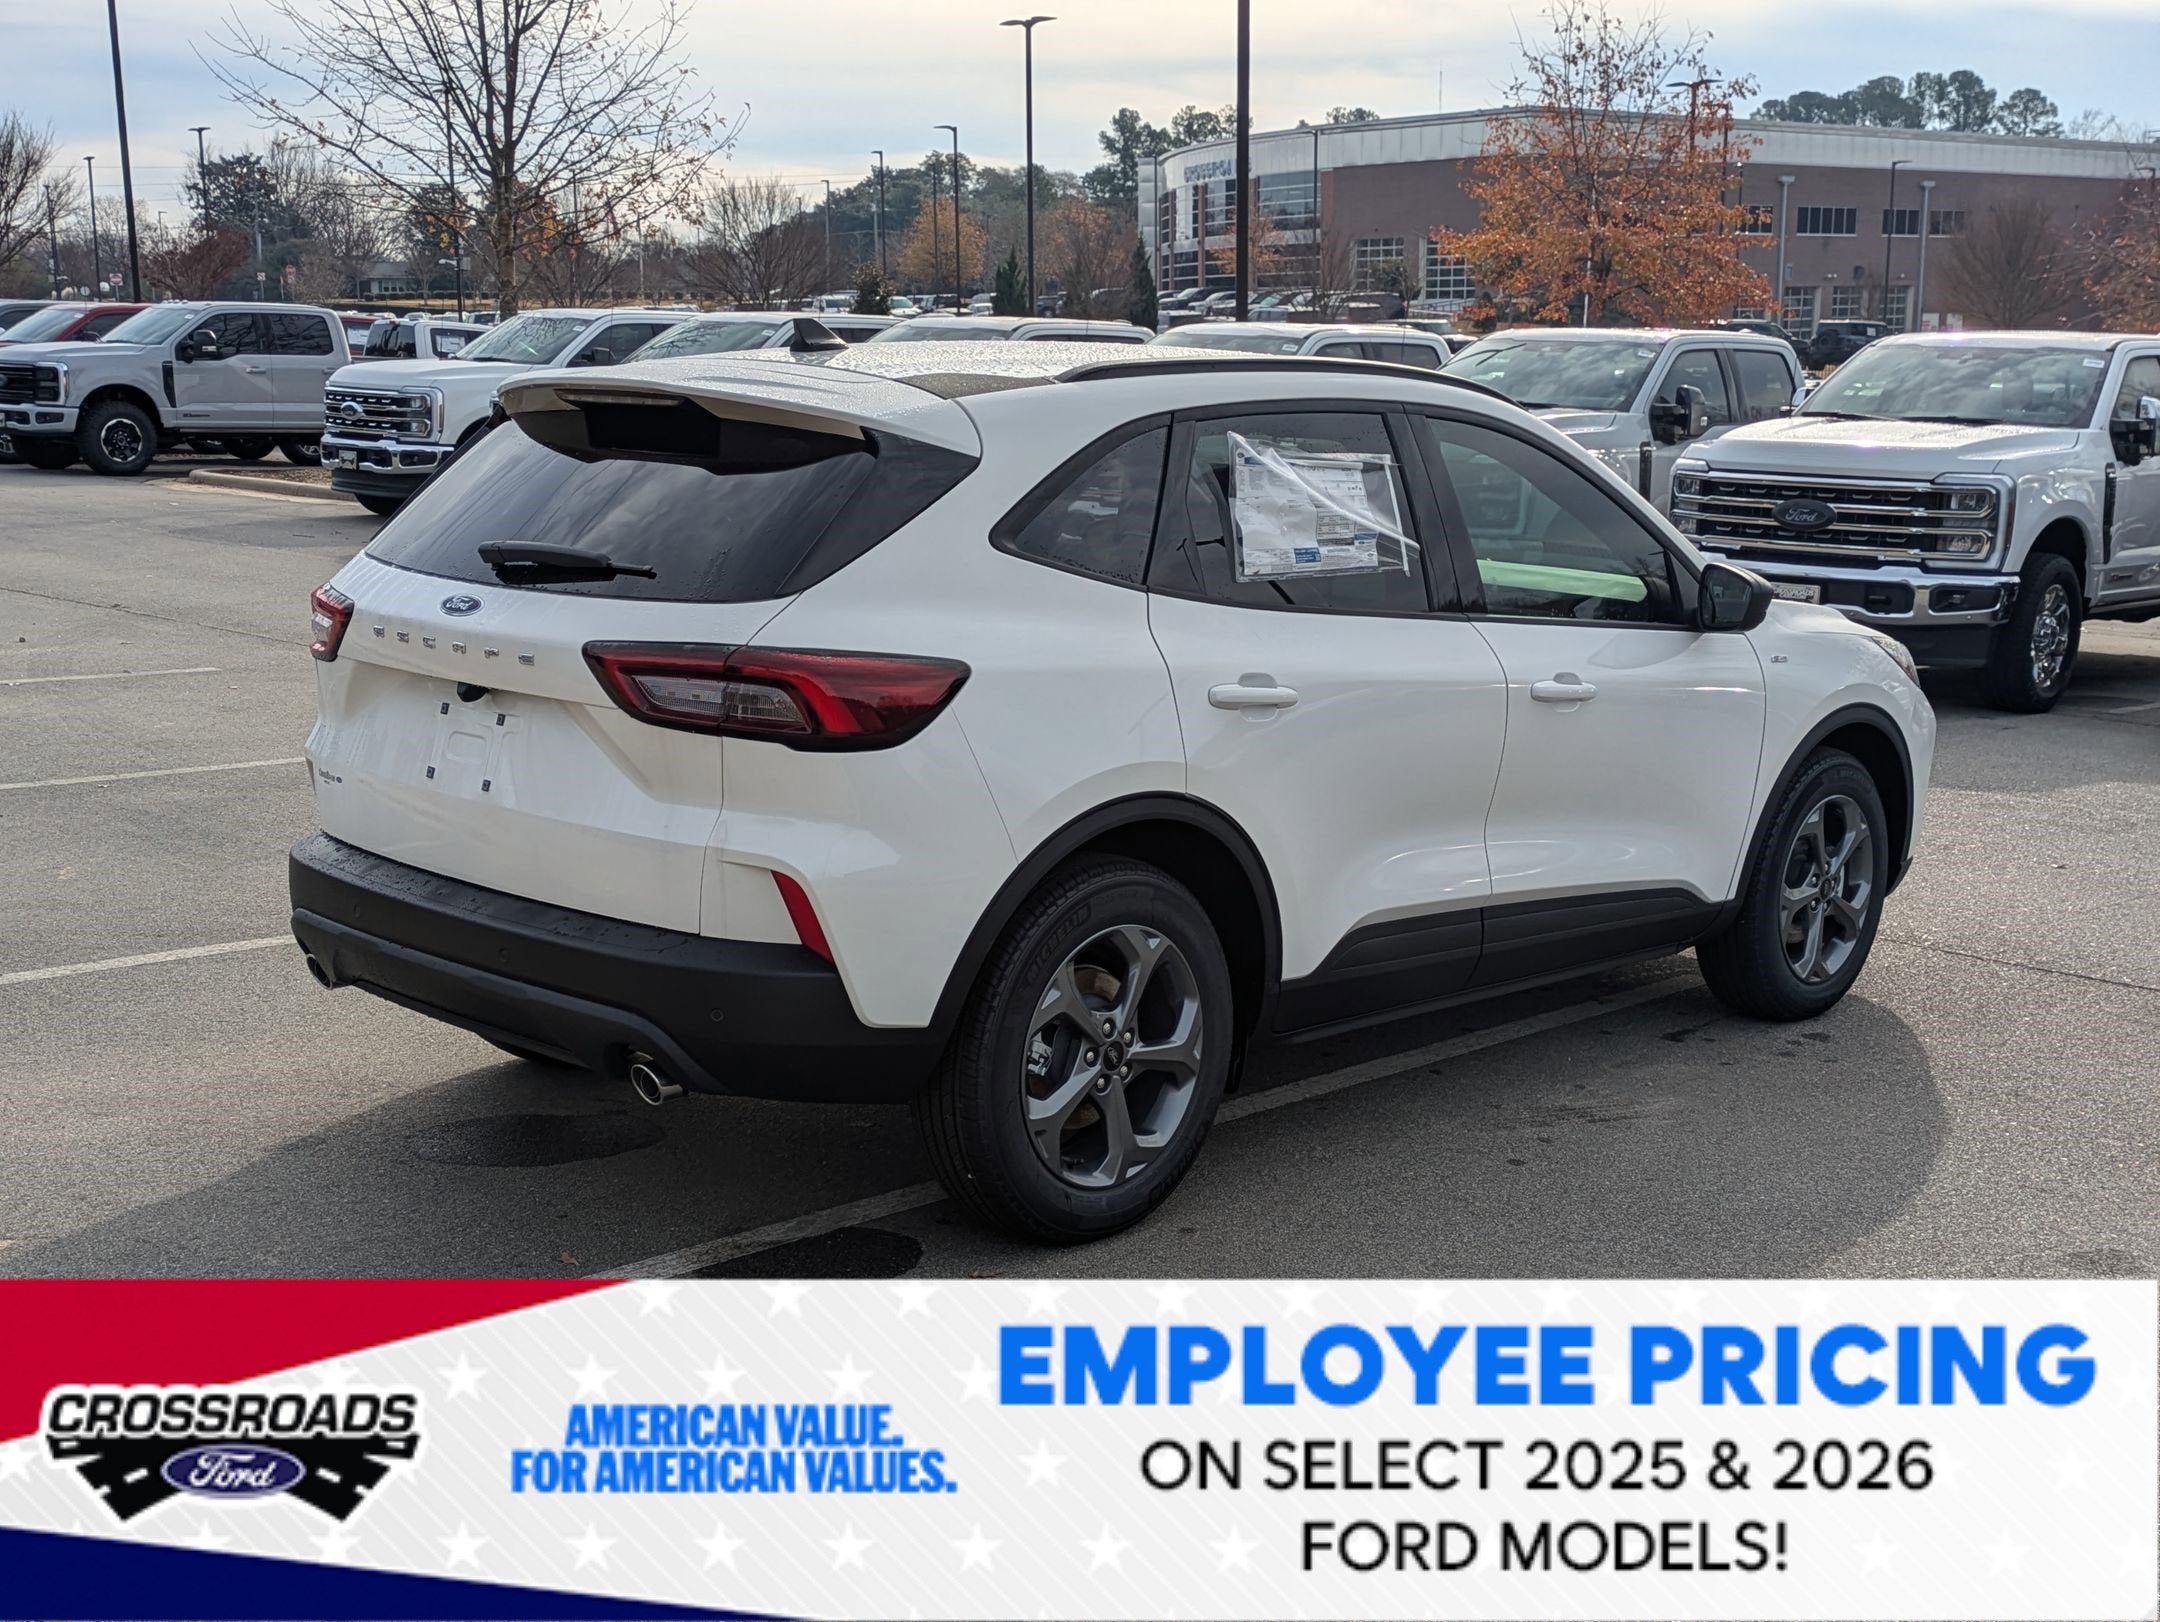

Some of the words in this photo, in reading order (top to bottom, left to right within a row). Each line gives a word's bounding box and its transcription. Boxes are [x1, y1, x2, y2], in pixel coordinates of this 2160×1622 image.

[1785, 508, 1818, 521] Ford
[446, 596, 473, 611] Ford
[373, 624, 535, 667] ESCAPE
